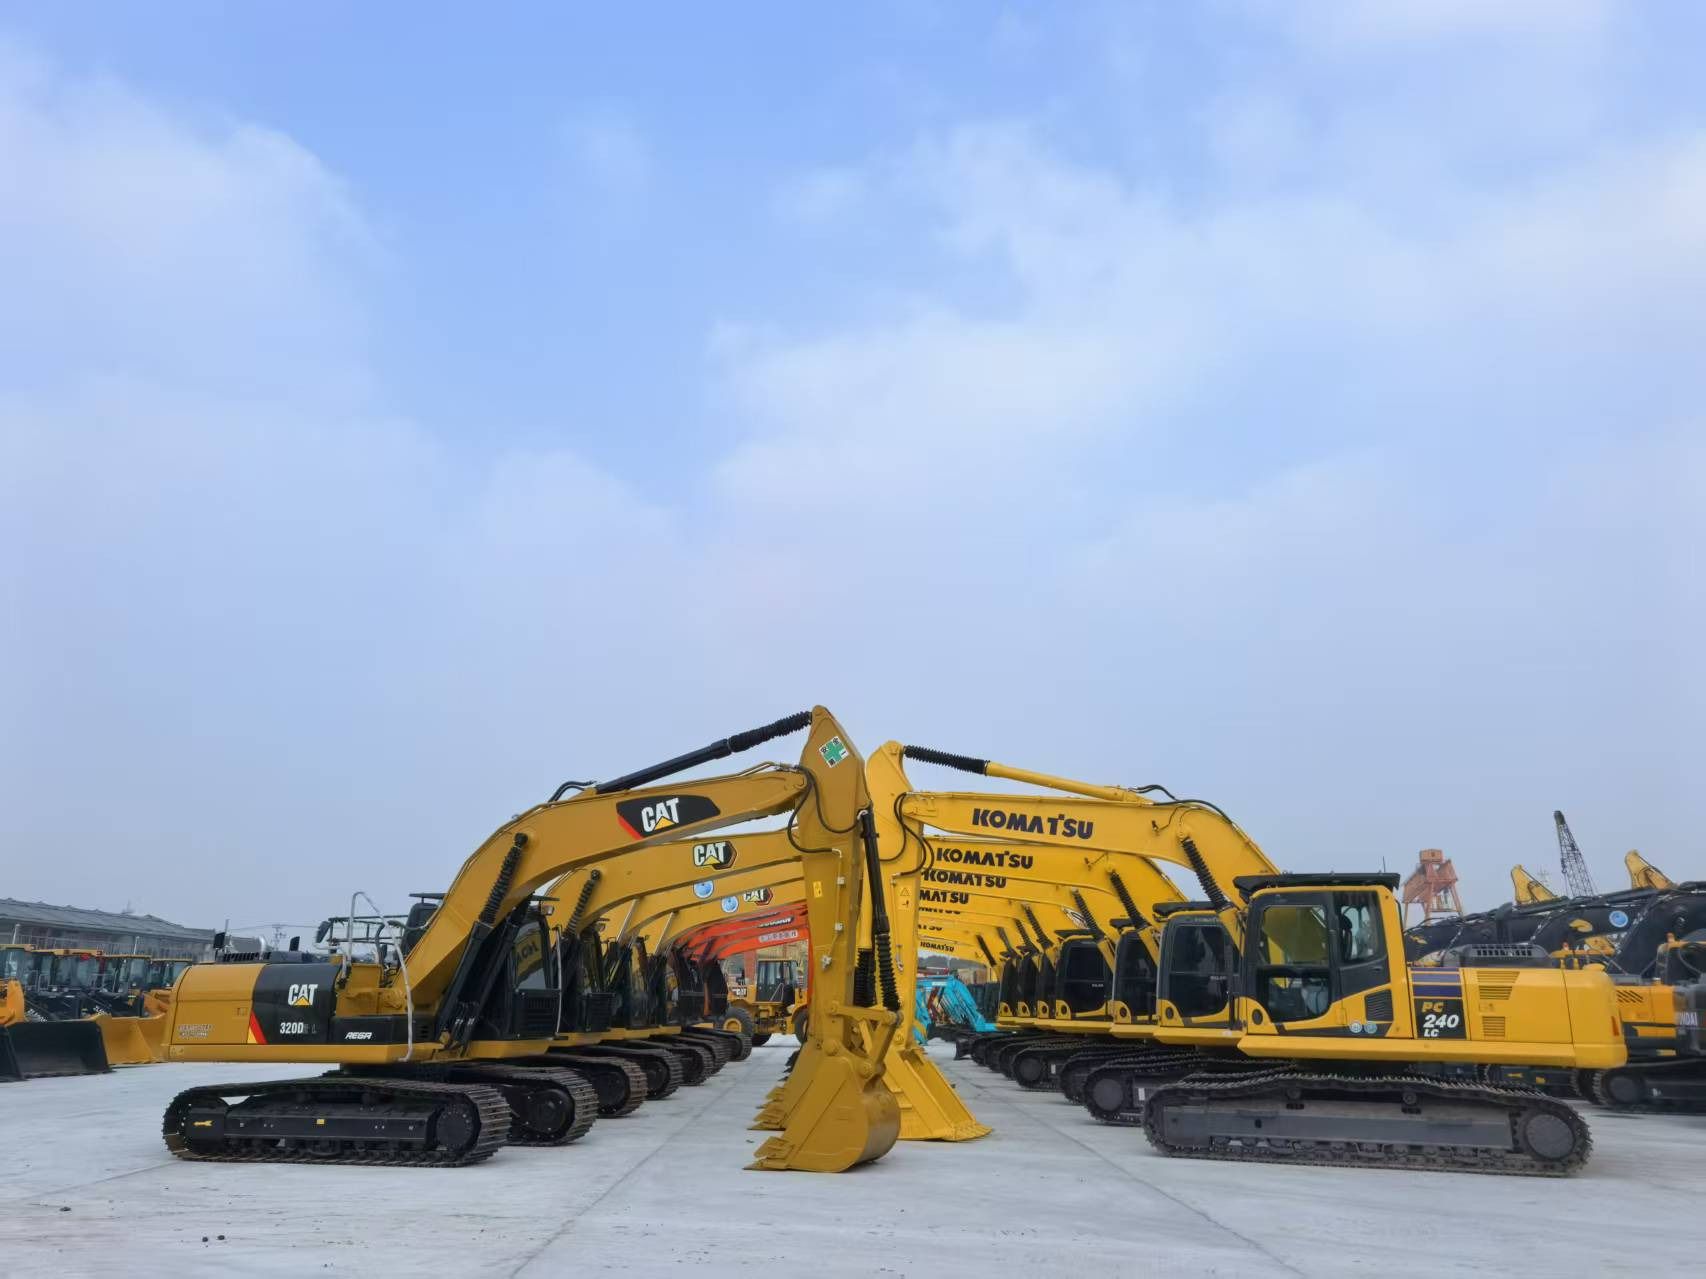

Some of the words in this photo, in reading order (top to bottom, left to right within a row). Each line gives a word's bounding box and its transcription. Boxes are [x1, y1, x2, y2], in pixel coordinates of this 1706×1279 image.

[641, 798, 679, 832] CAT
[972, 808, 1094, 839] KOMATSU
[694, 842, 726, 866] CAT
[936, 848, 1034, 869] KOMATSU
[921, 868, 1007, 888] KOMATSU
[919, 890, 969, 904] MATSU
[920, 941, 955, 952] KOMATSU
[287, 984, 318, 1006] CAT
[1422, 1002, 1444, 1013] PC
[280, 1022, 304, 1034] 320D
[1423, 1014, 1460, 1028] 240
[1424, 1029, 1440, 1037] LC
